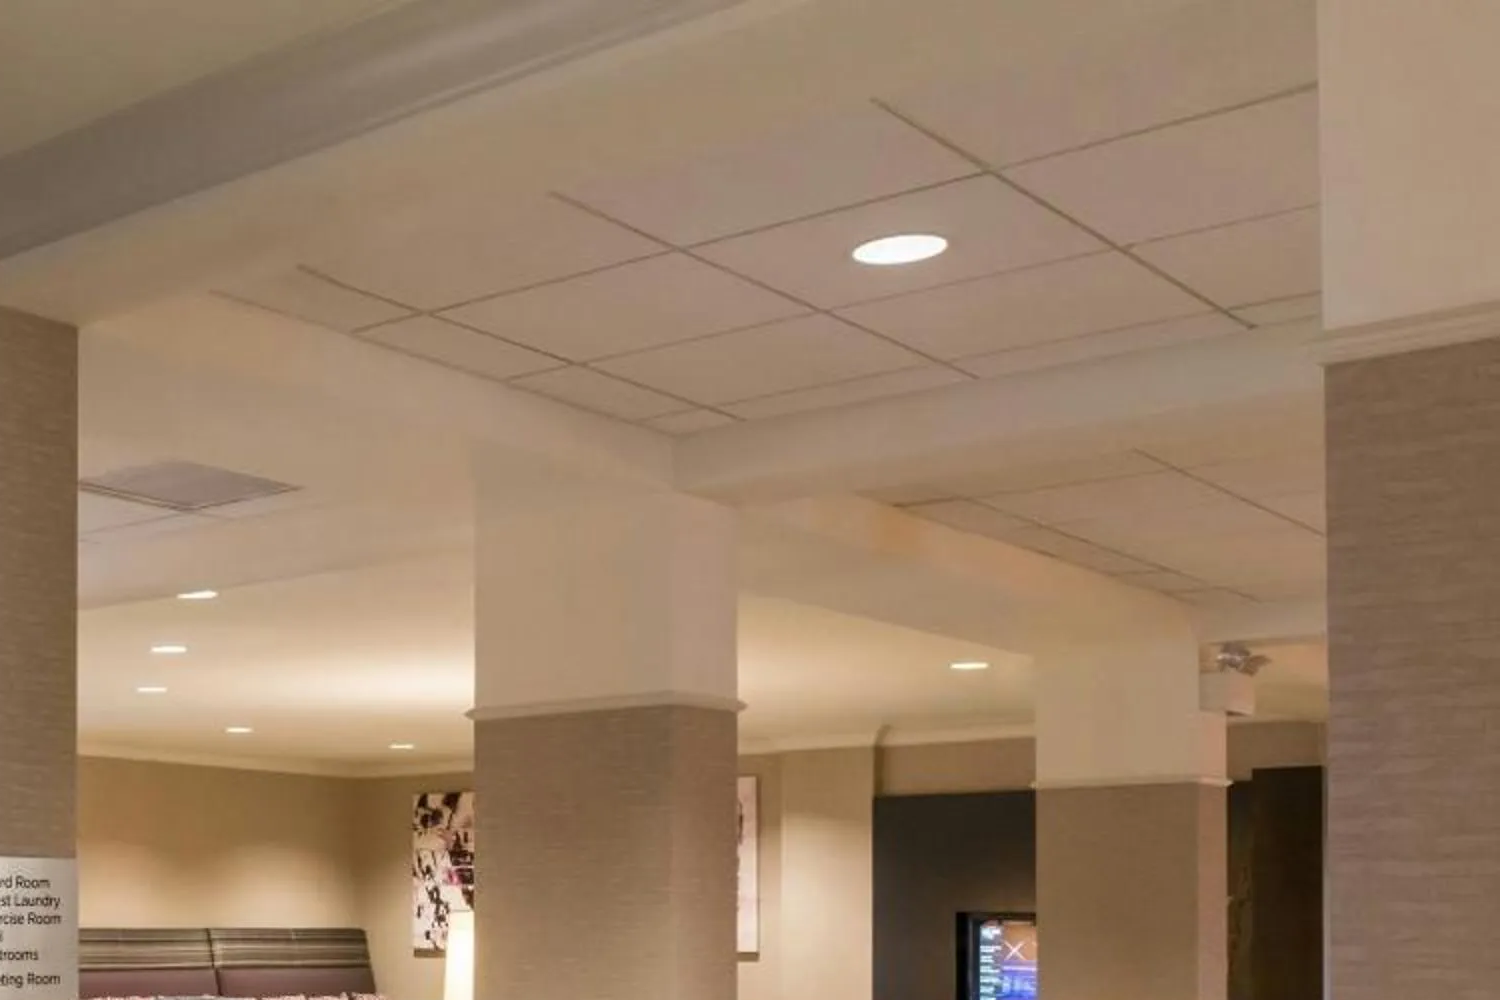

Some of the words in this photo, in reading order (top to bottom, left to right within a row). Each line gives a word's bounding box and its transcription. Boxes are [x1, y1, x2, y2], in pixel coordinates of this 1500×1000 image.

[15, 876, 50, 889] Room
[14, 895, 61, 910] Laundry
[27, 912, 62, 925] Room
[27, 972, 61, 985] Room
